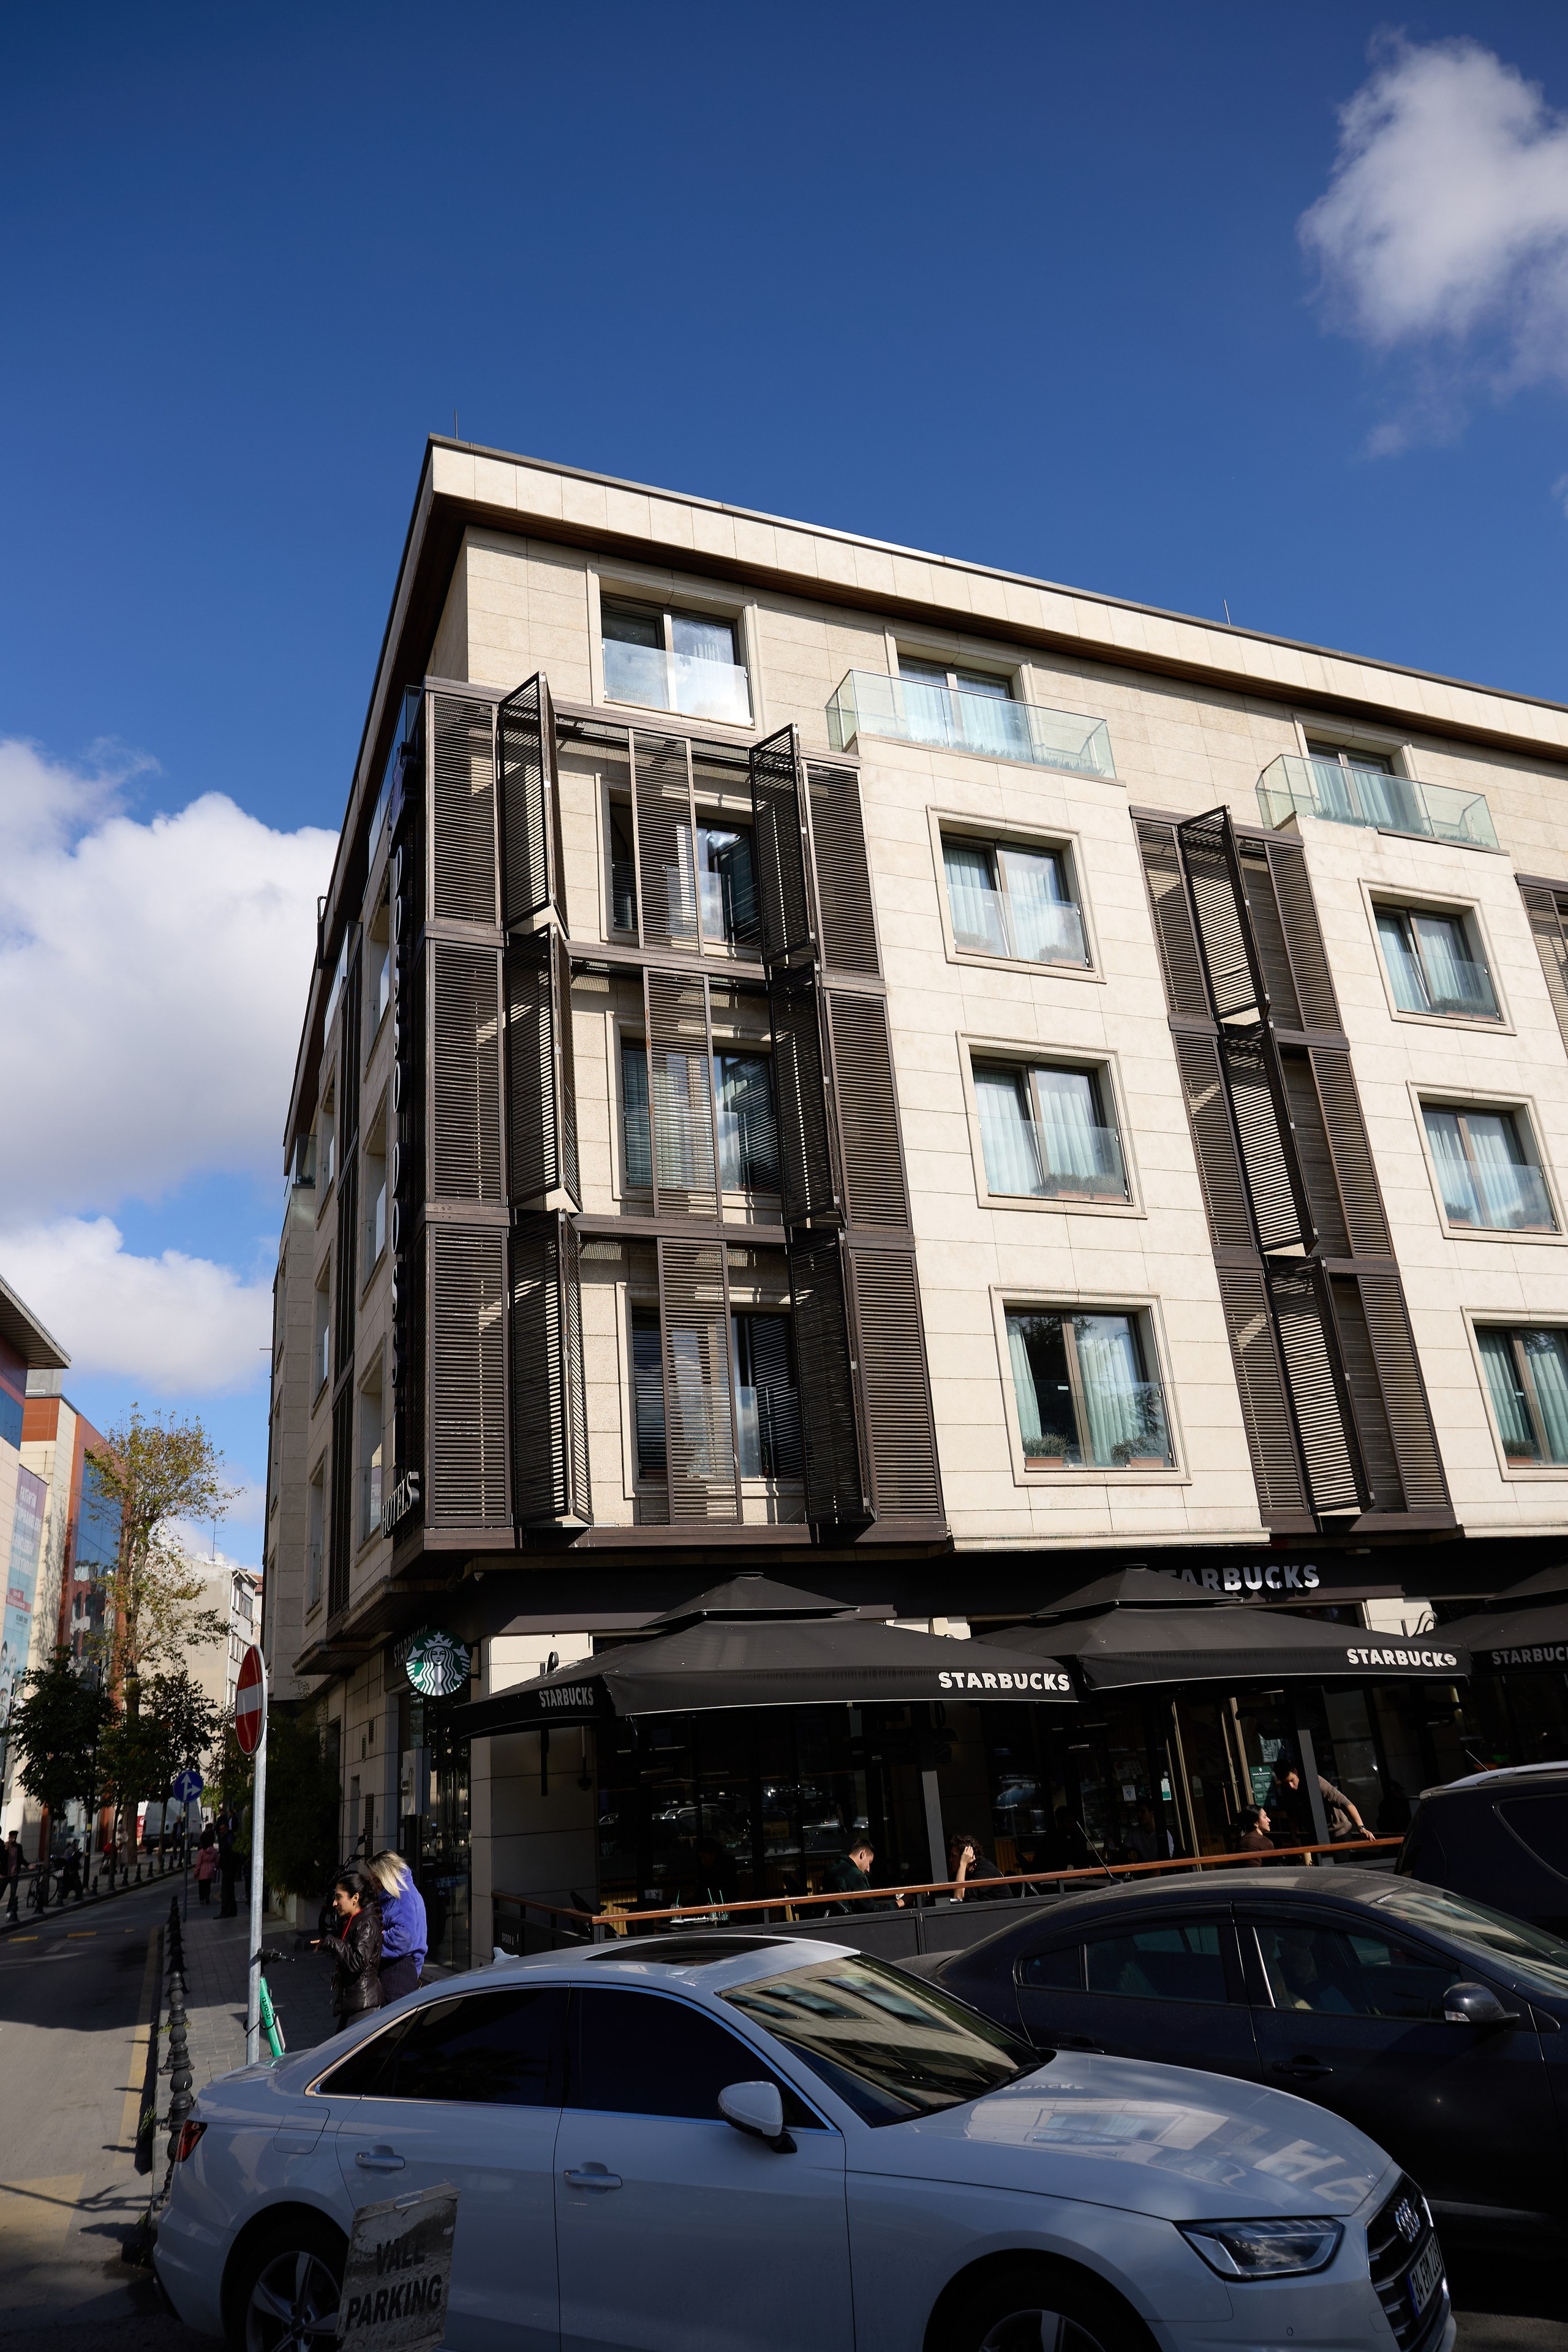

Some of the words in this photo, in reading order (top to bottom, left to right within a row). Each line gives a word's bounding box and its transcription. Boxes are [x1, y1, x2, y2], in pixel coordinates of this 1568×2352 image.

[382, 1471, 415, 1539] HOTELS
[1346, 1648, 1457, 1667] STARBUCKS
[1491, 1646, 1568, 1665] STARBUC
[938, 1672, 1071, 1692] STARBUCKS
[538, 1687, 594, 1708] STARBUCKS
[1412, 2270, 1425, 2306] 34
[1420, 2252, 1434, 2294] EPM
[1428, 2237, 1441, 2277] 228
[345, 2275, 442, 2332] PARKING
